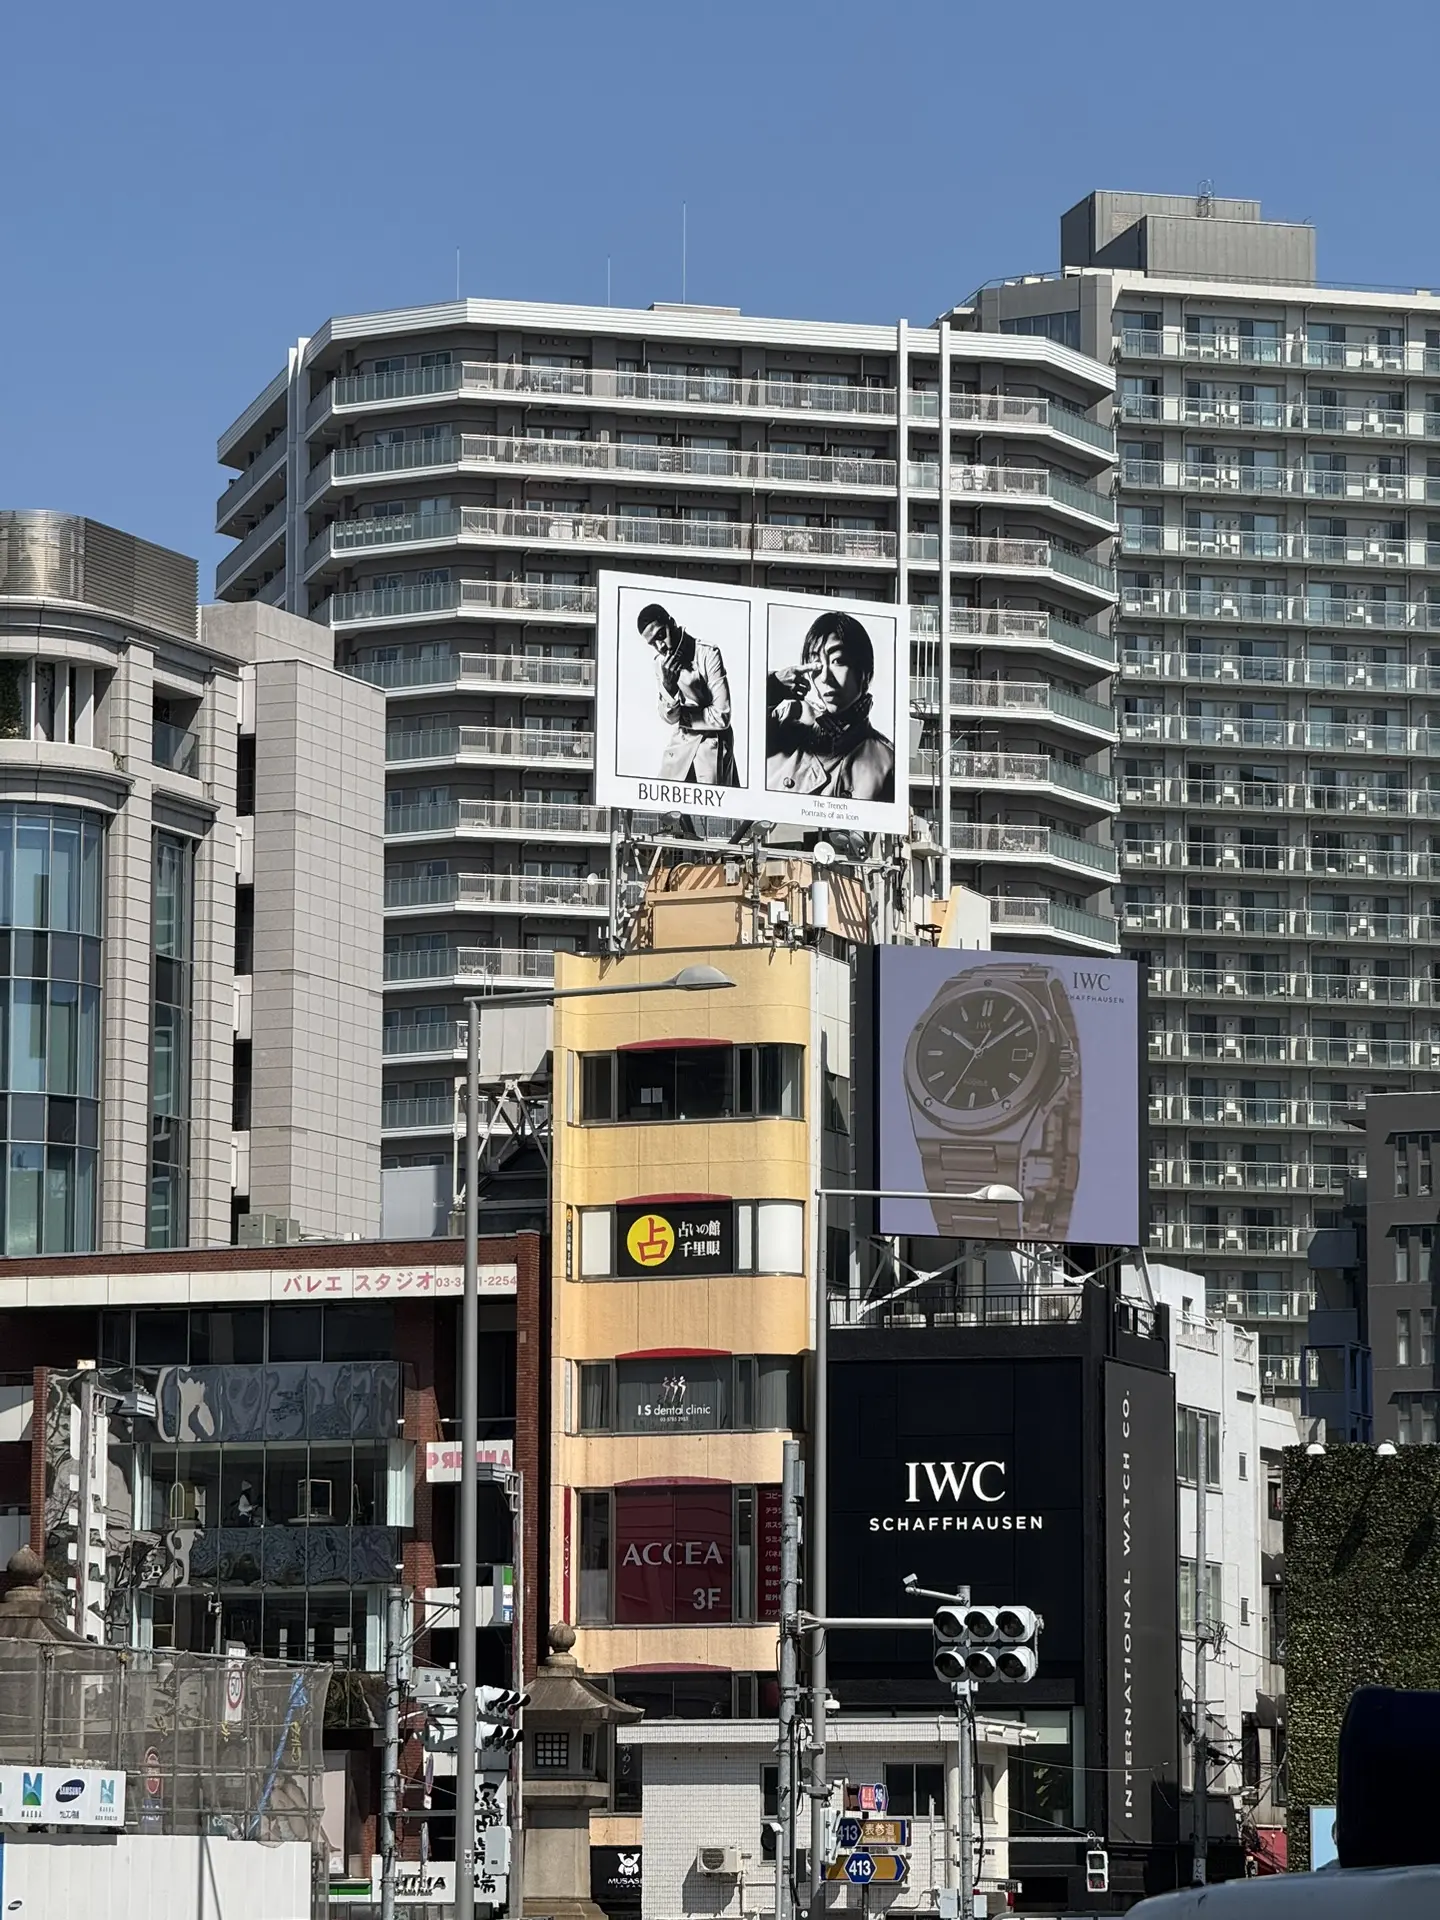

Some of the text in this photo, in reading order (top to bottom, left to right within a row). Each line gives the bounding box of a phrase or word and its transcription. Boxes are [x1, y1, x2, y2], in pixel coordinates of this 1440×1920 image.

[638, 782, 726, 807] BURBERRY
[813, 800, 848, 810] The Trench
[801, 809, 827, 818] Portraits
[846, 813, 860, 821] Icon
[1073, 971, 1111, 992] IWC
[637, 1217, 669, 1263] 占
[678, 1220, 721, 1239] 占いの館
[679, 1240, 721, 1258] 千里眼
[283, 1274, 343, 1293] バレエ
[354, 1271, 434, 1292] スタジオ
[653, 1403, 684, 1416] dental
[685, 1403, 711, 1415] clinic
[905, 1460, 1006, 1503] IWC
[869, 1515, 1043, 1532] SCHAFFHAUSEN
[622, 1541, 724, 1567] ACCEA
[692, 1588, 722, 1610] 3F
[1123, 1390, 1132, 1819] INTERNATIONAL WATCH CO.
[848, 1860, 871, 1877] 413
